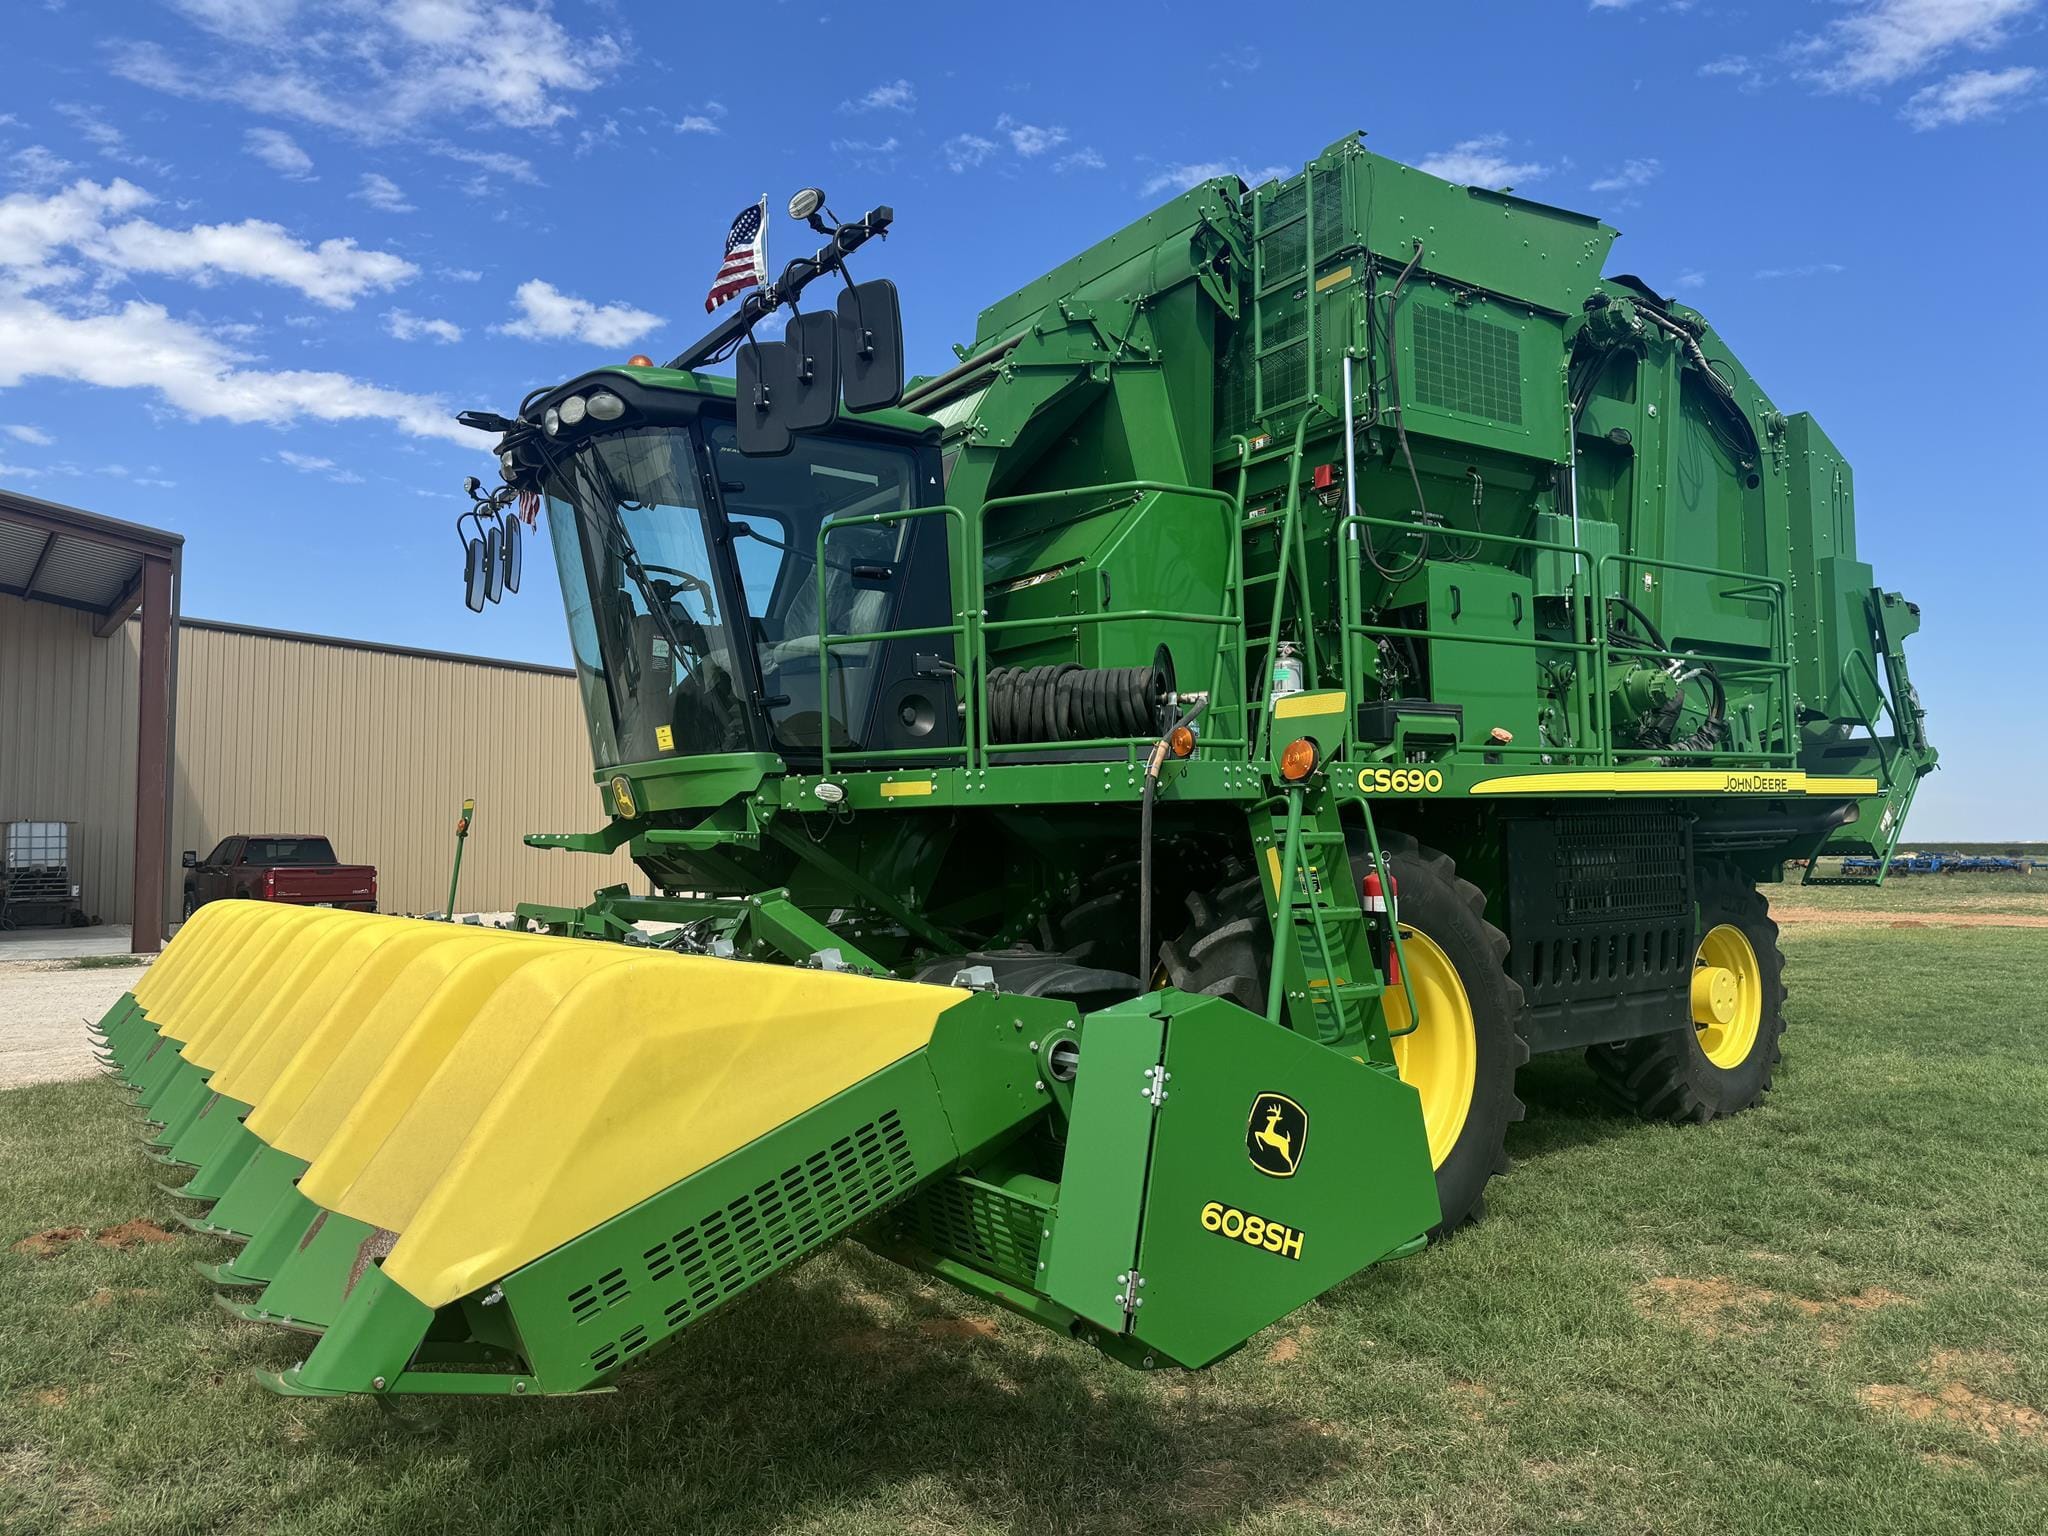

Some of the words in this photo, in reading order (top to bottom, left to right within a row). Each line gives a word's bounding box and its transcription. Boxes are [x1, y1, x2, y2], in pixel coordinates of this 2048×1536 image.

[1357, 767, 1443, 793] CS690
[1723, 775, 1752, 790] JOHN
[1753, 775, 1788, 790] DEERE
[1200, 1201, 1305, 1260] 608SH
